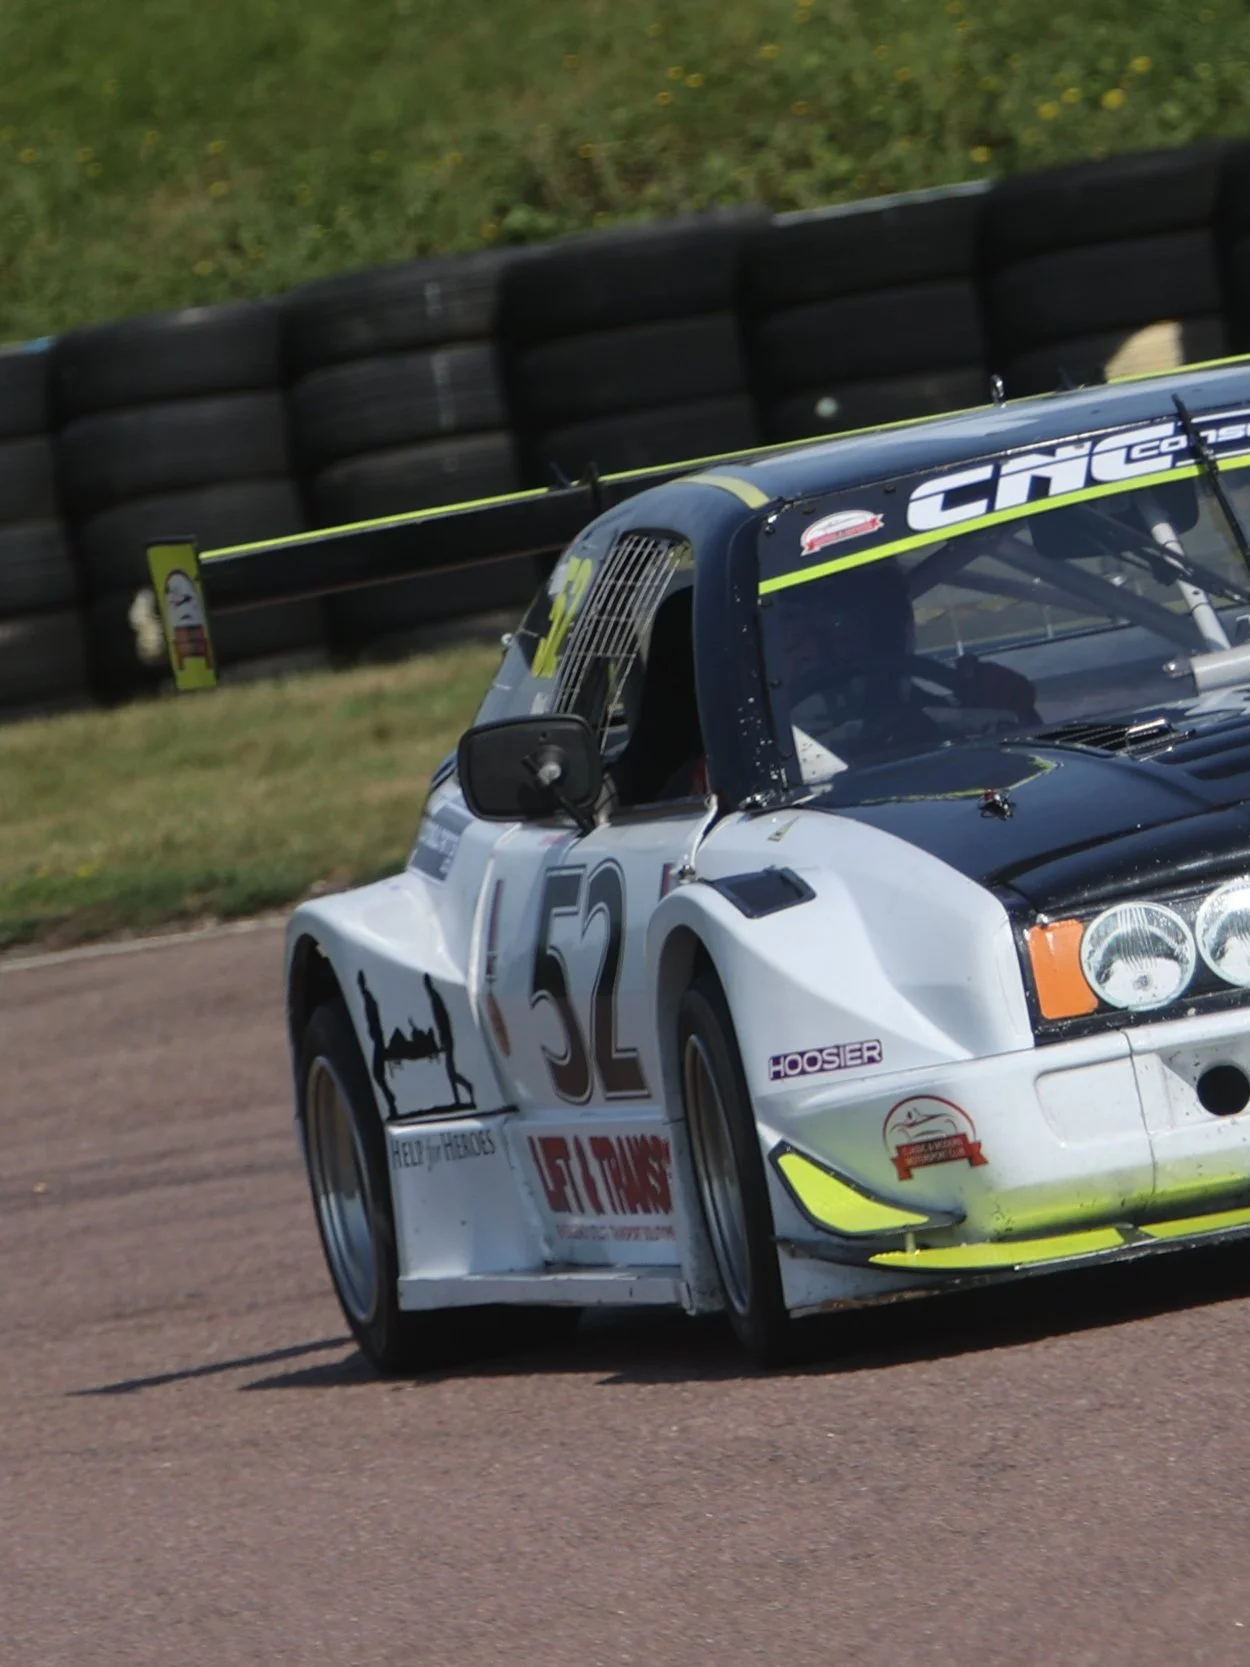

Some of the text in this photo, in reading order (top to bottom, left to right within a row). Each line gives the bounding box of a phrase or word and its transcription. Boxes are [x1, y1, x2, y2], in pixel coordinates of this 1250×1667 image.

[907, 421, 1175, 531] CNC
[530, 857, 652, 1105] 52
[769, 1041, 881, 1078] HOOSIER
[390, 1139, 424, 1169] HELP
[440, 1128, 496, 1161] HEROES
